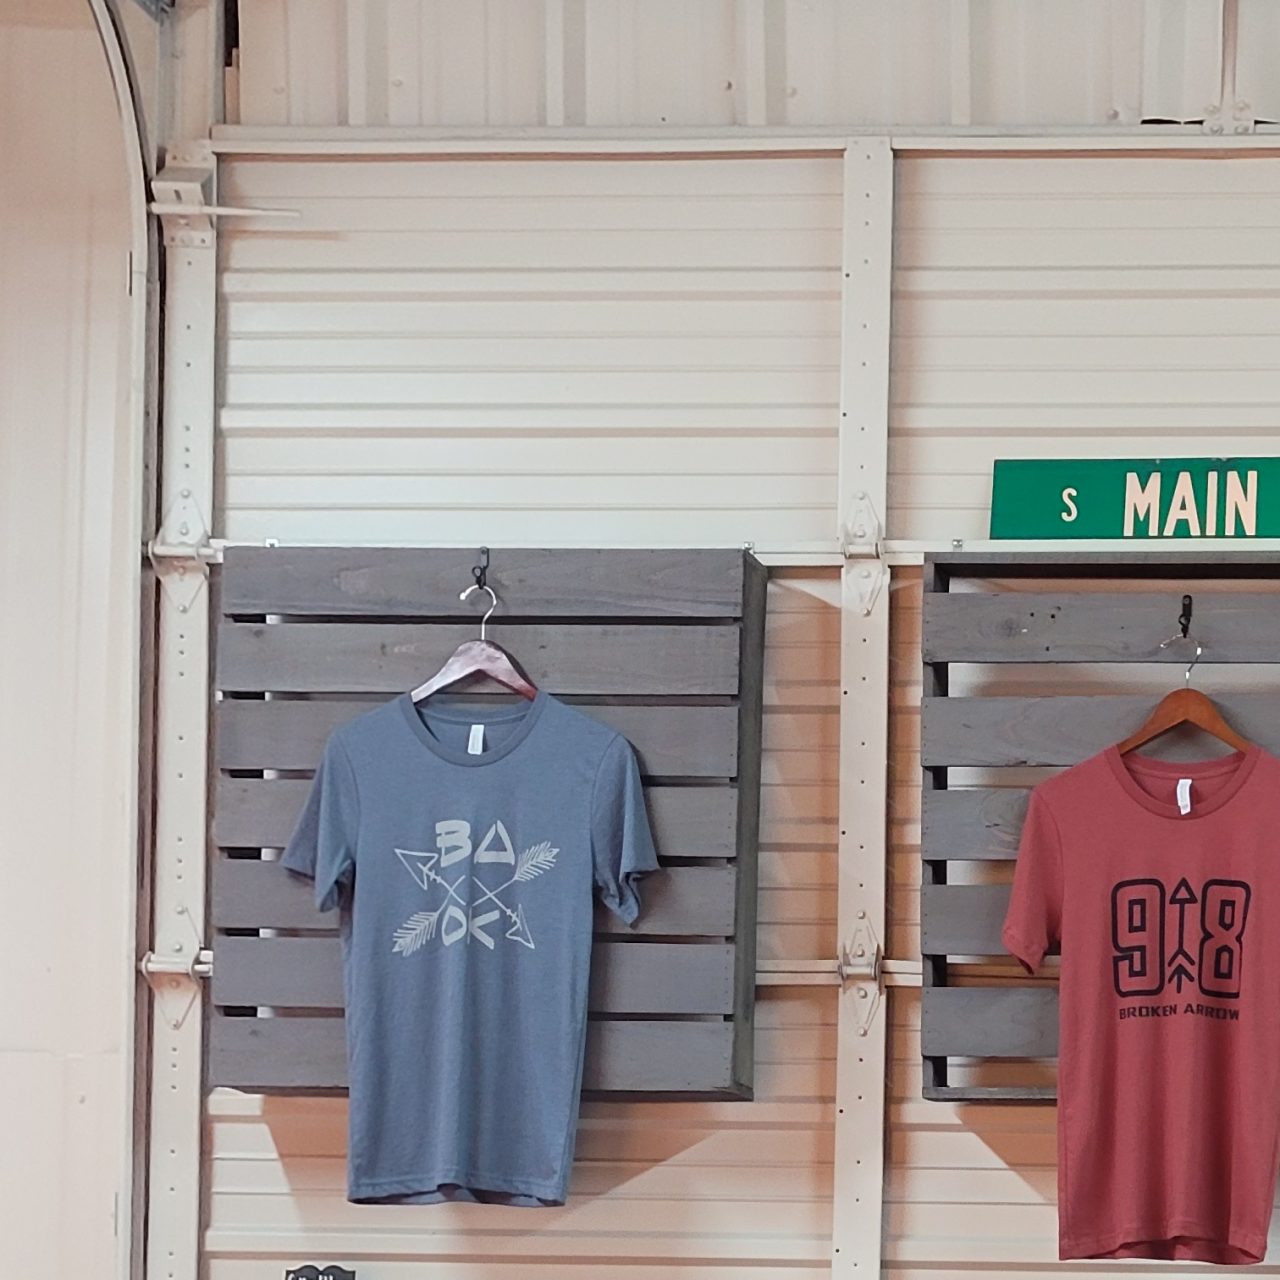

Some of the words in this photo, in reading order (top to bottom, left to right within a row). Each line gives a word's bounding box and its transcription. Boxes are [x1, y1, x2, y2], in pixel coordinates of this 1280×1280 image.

[1061, 487, 1078, 522] S
[1123, 470, 1258, 538] MAIN
[441, 904, 500, 950] OK
[1119, 1004, 1177, 1020] BROKEN
[1183, 1003, 1240, 1020] ARROW
